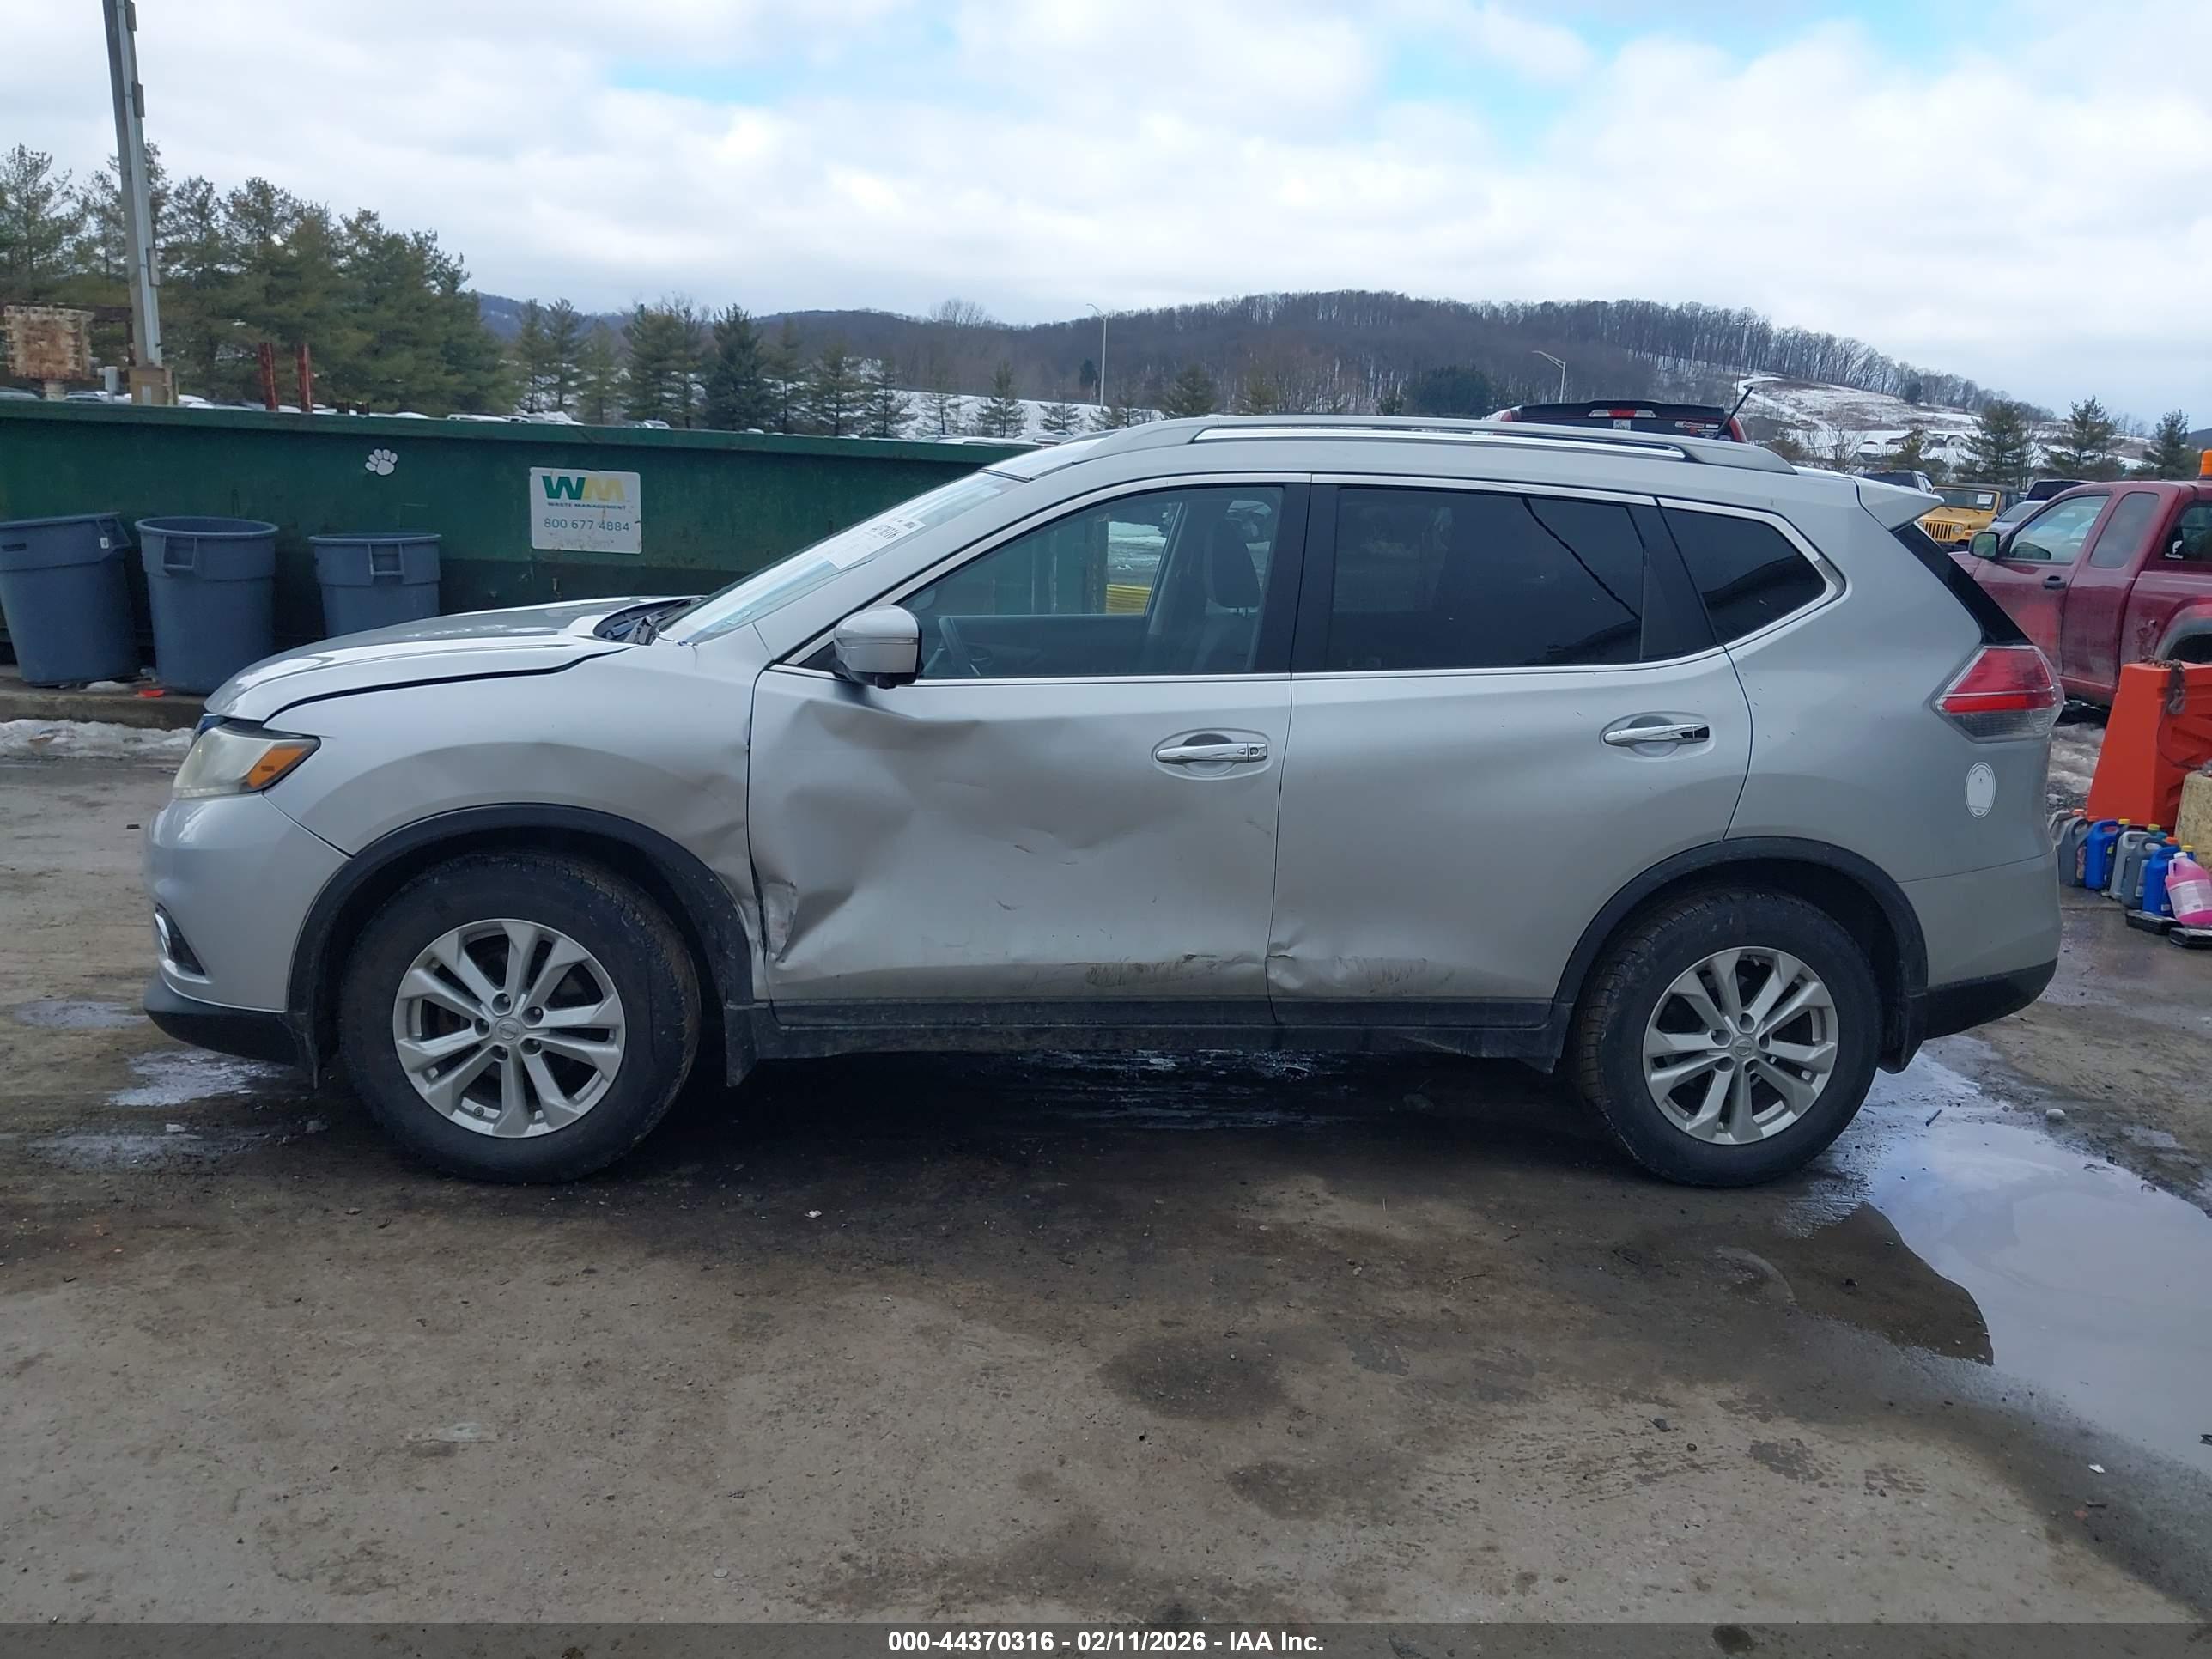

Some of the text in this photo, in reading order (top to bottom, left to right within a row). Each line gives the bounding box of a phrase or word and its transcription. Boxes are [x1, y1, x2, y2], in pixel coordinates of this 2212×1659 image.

[542, 476, 625, 501] WM
[544, 518, 630, 532] 800 677 4884
